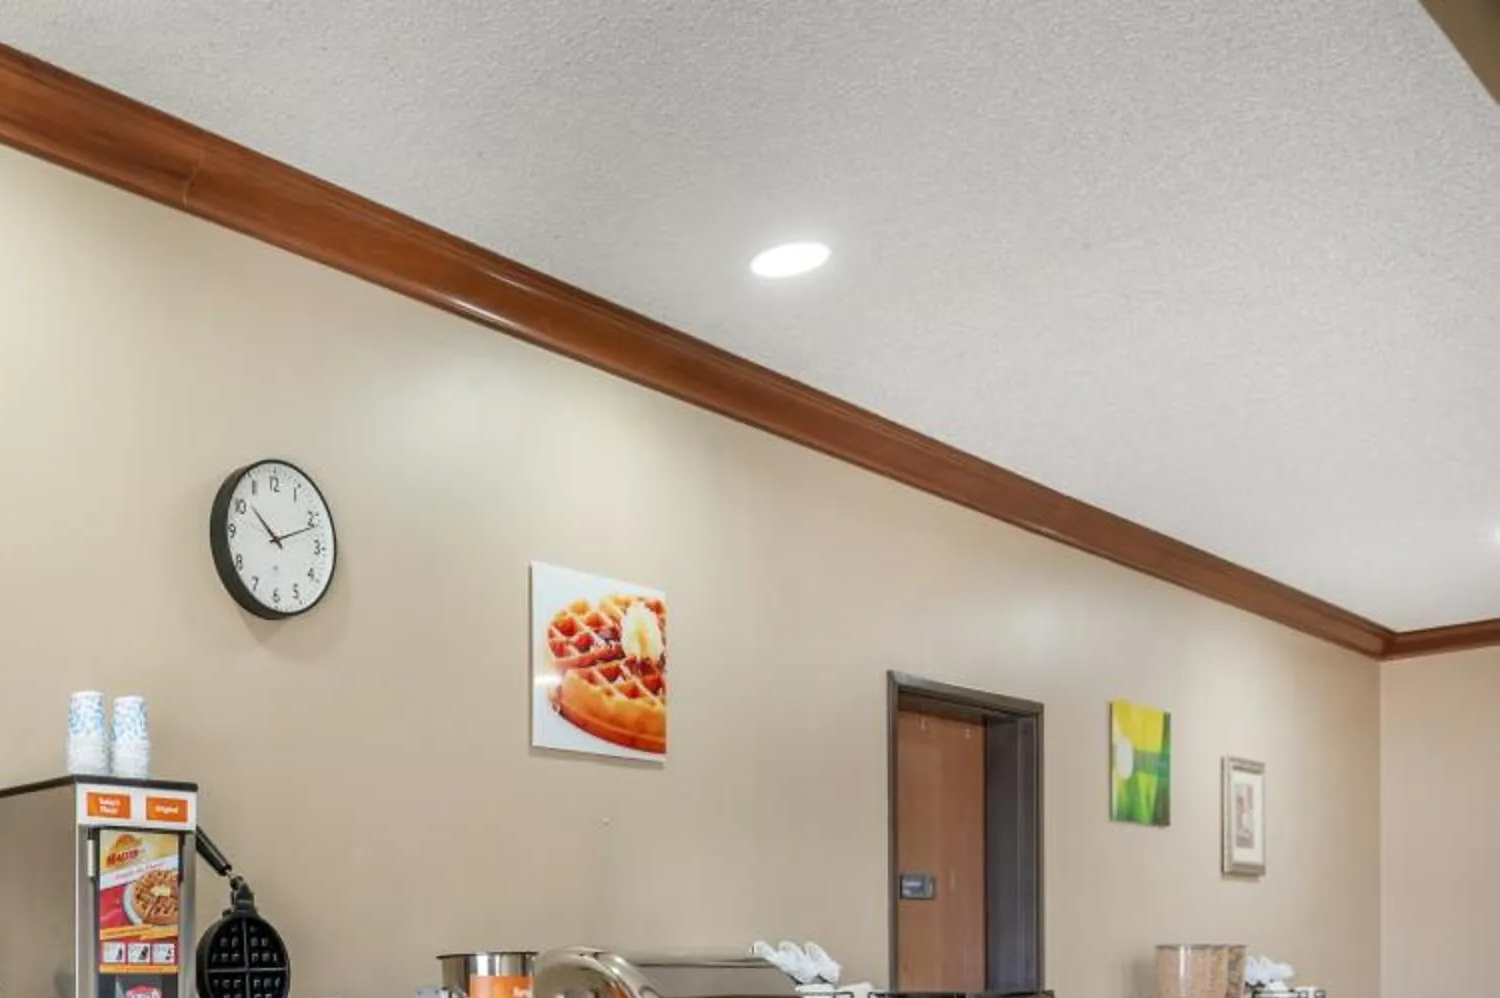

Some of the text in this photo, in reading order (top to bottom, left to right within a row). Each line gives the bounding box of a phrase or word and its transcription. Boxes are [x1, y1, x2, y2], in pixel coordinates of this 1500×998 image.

[269, 476, 281, 493] 12
[234, 499, 247, 515] 10
[227, 523, 237, 539] 9
[313, 539, 321, 556] 3
[234, 554, 244, 571] 8
[251, 576, 259, 591] 7
[272, 588, 281, 603] 6
